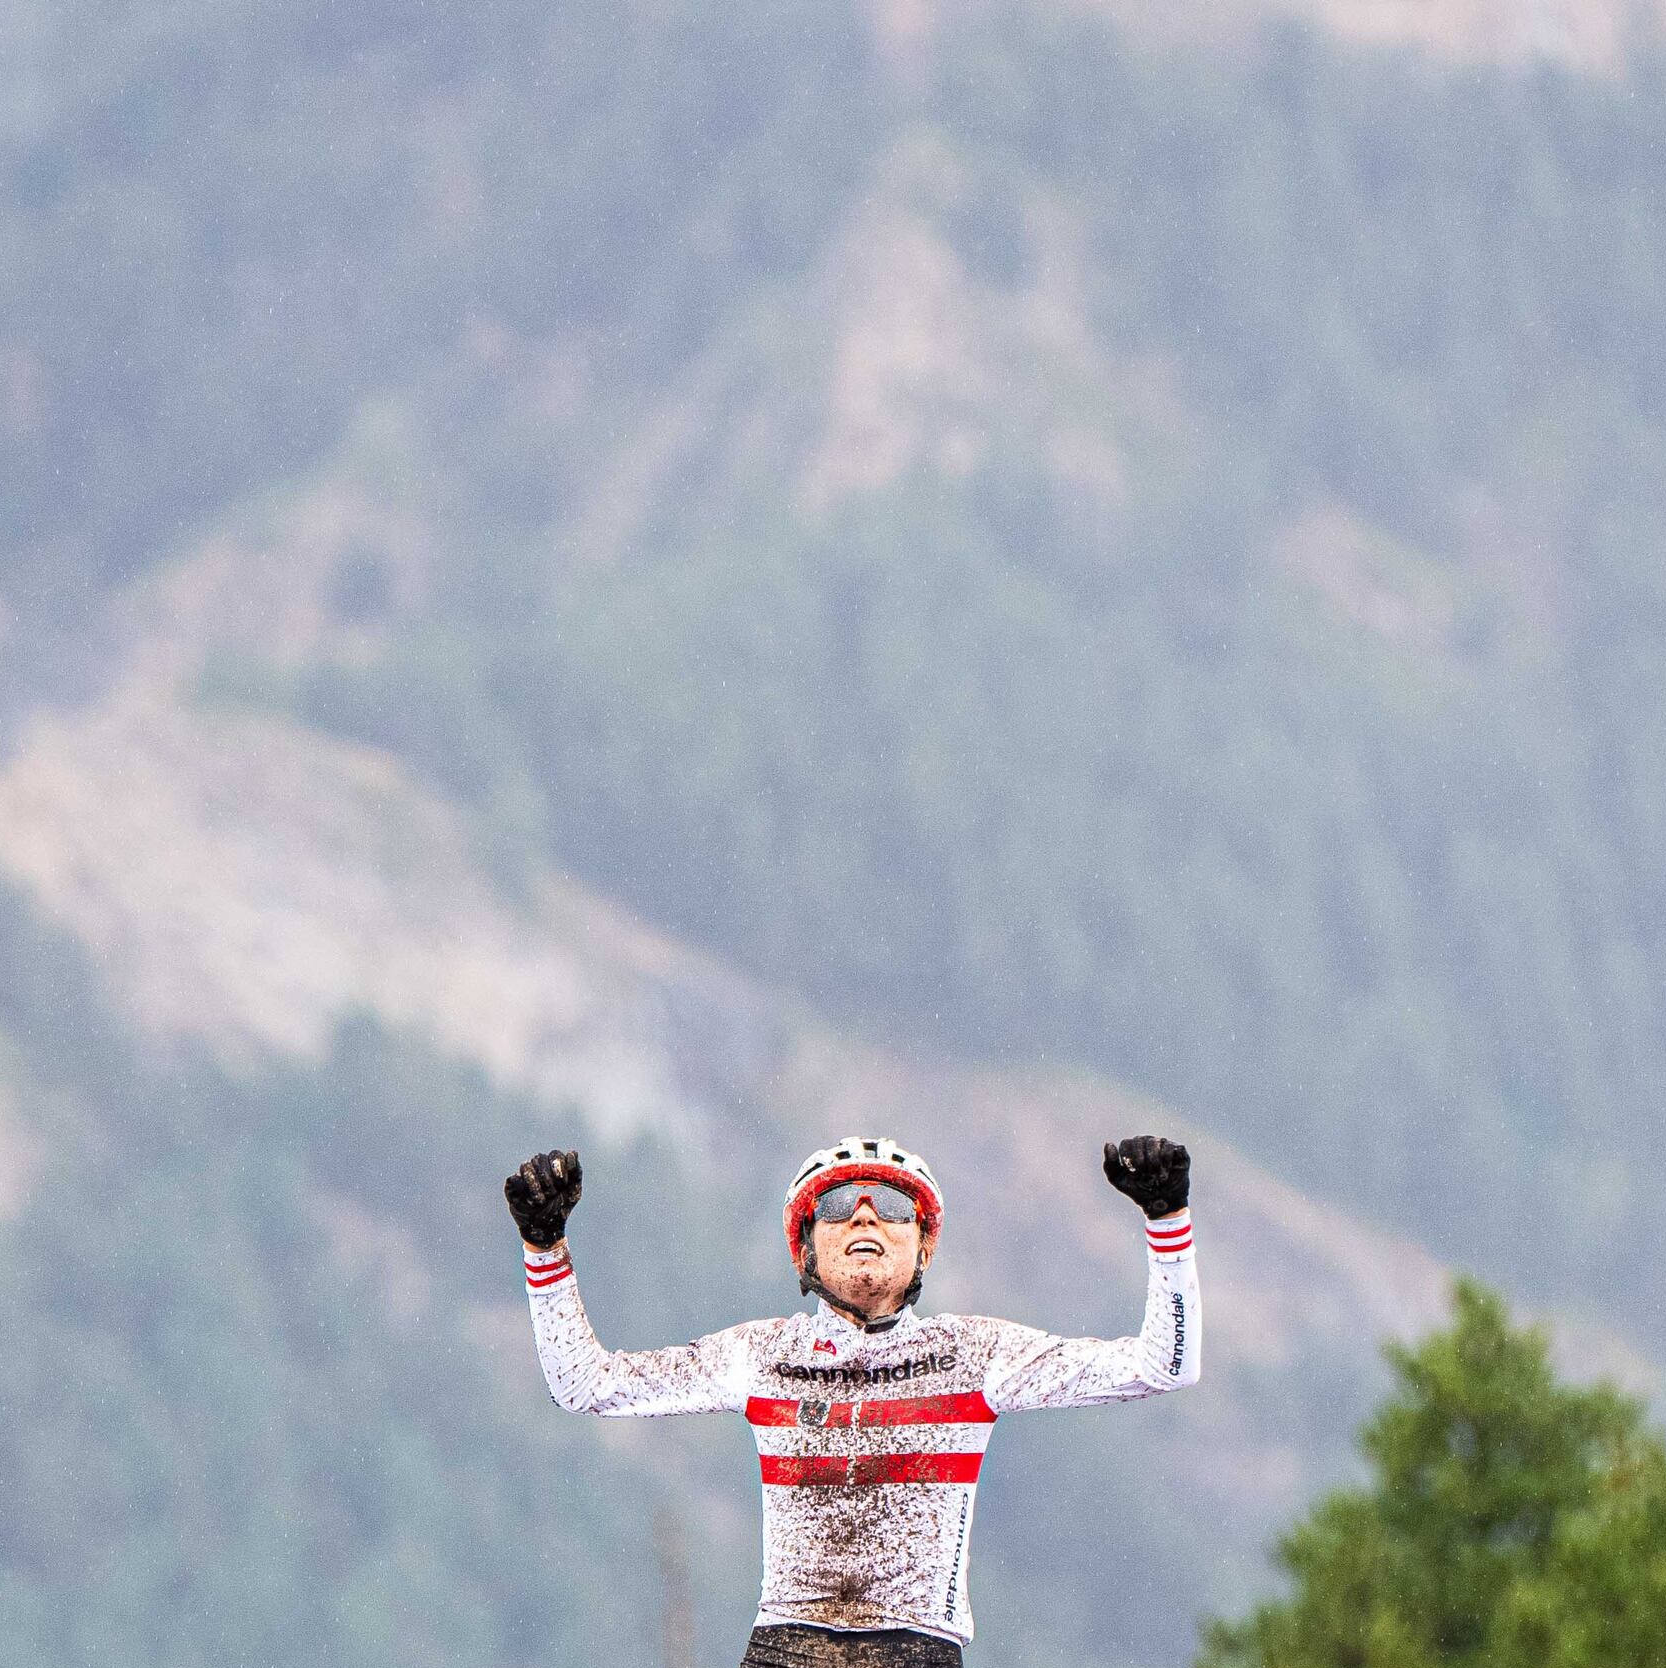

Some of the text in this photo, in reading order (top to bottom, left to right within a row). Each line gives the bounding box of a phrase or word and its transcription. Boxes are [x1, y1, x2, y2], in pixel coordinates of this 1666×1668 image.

[776, 1352, 957, 1385] cannondale
[1168, 1292, 1185, 1376] cannondale
[944, 1492, 969, 1622] cannondale
